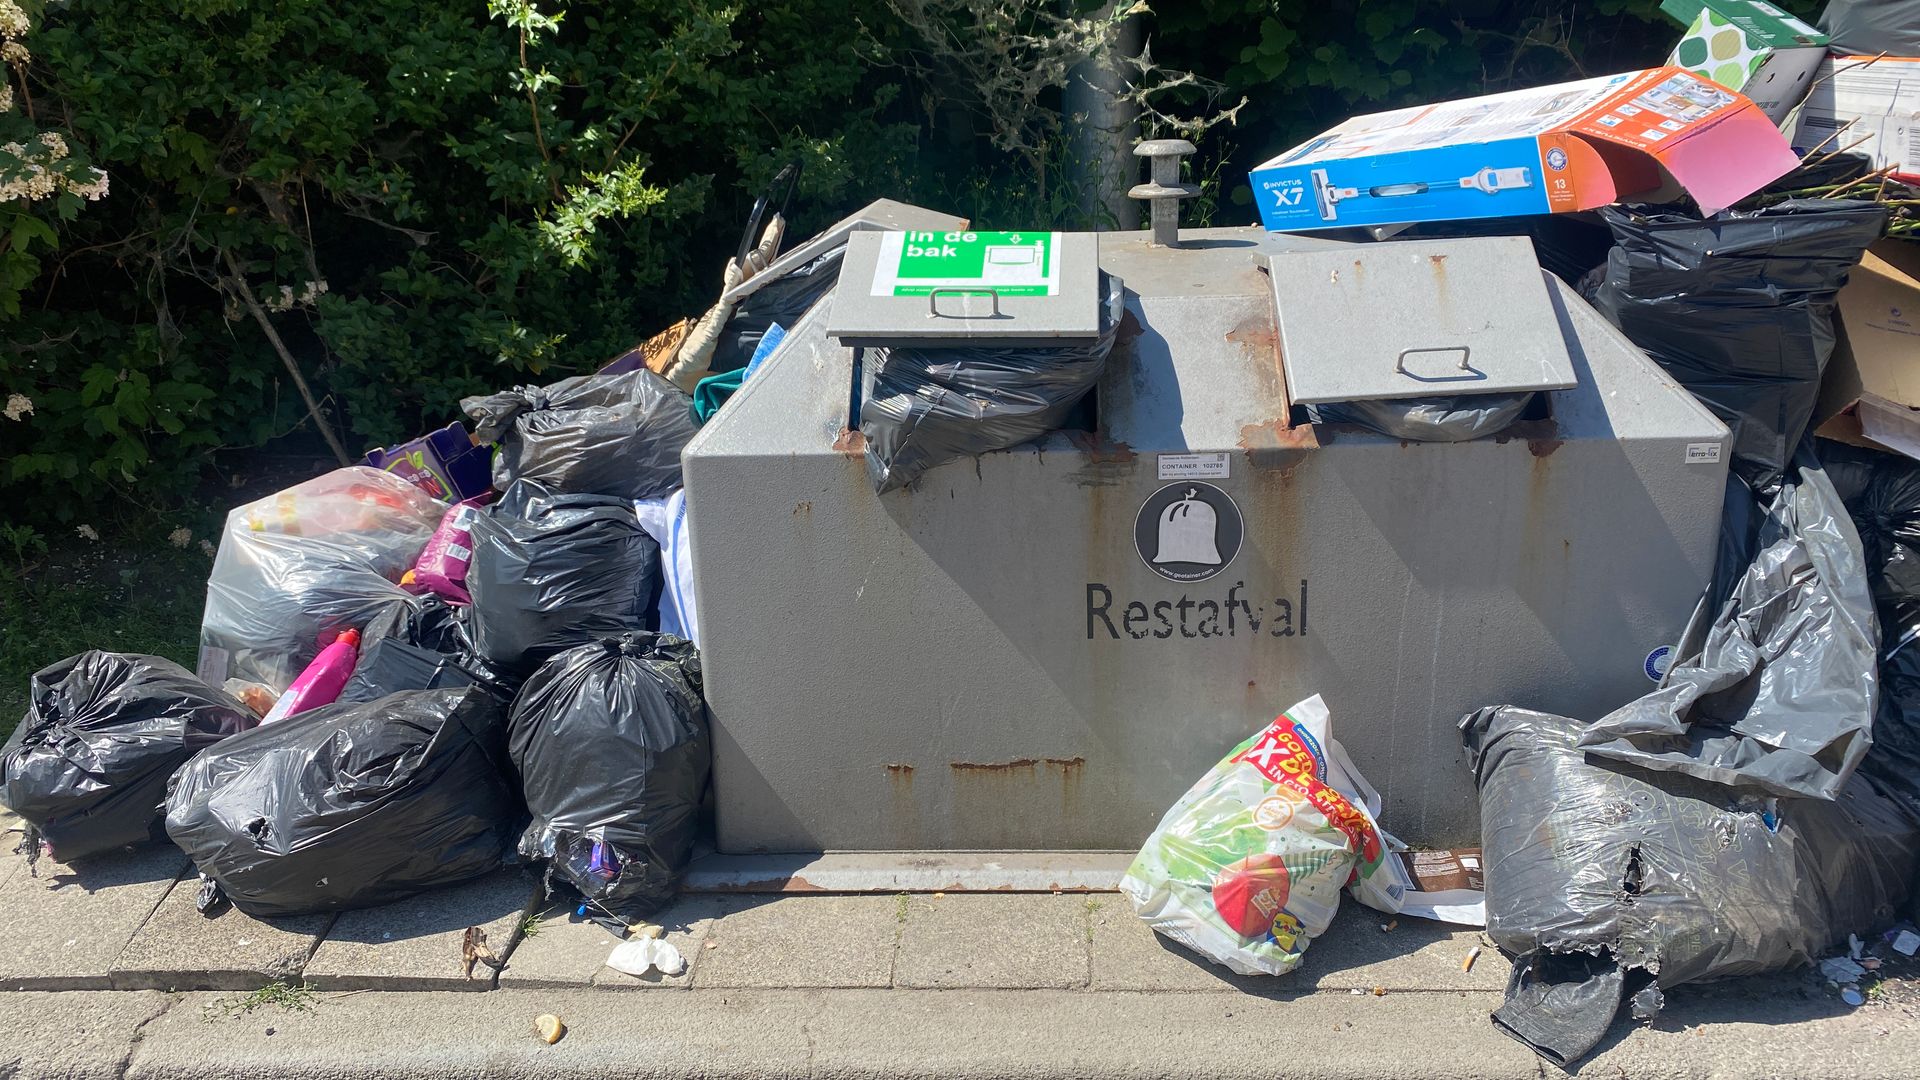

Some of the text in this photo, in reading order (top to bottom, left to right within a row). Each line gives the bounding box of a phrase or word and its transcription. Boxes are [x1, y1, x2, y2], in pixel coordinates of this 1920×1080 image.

[1269, 178, 1303, 189] INVICTUS
[1554, 178, 1566, 190] 13
[1271, 187, 1304, 207] X7
[944, 231, 978, 243] de
[906, 244, 957, 257] bak
[1086, 579, 1308, 640] Restafval
[1267, 764, 1285, 782] IN
